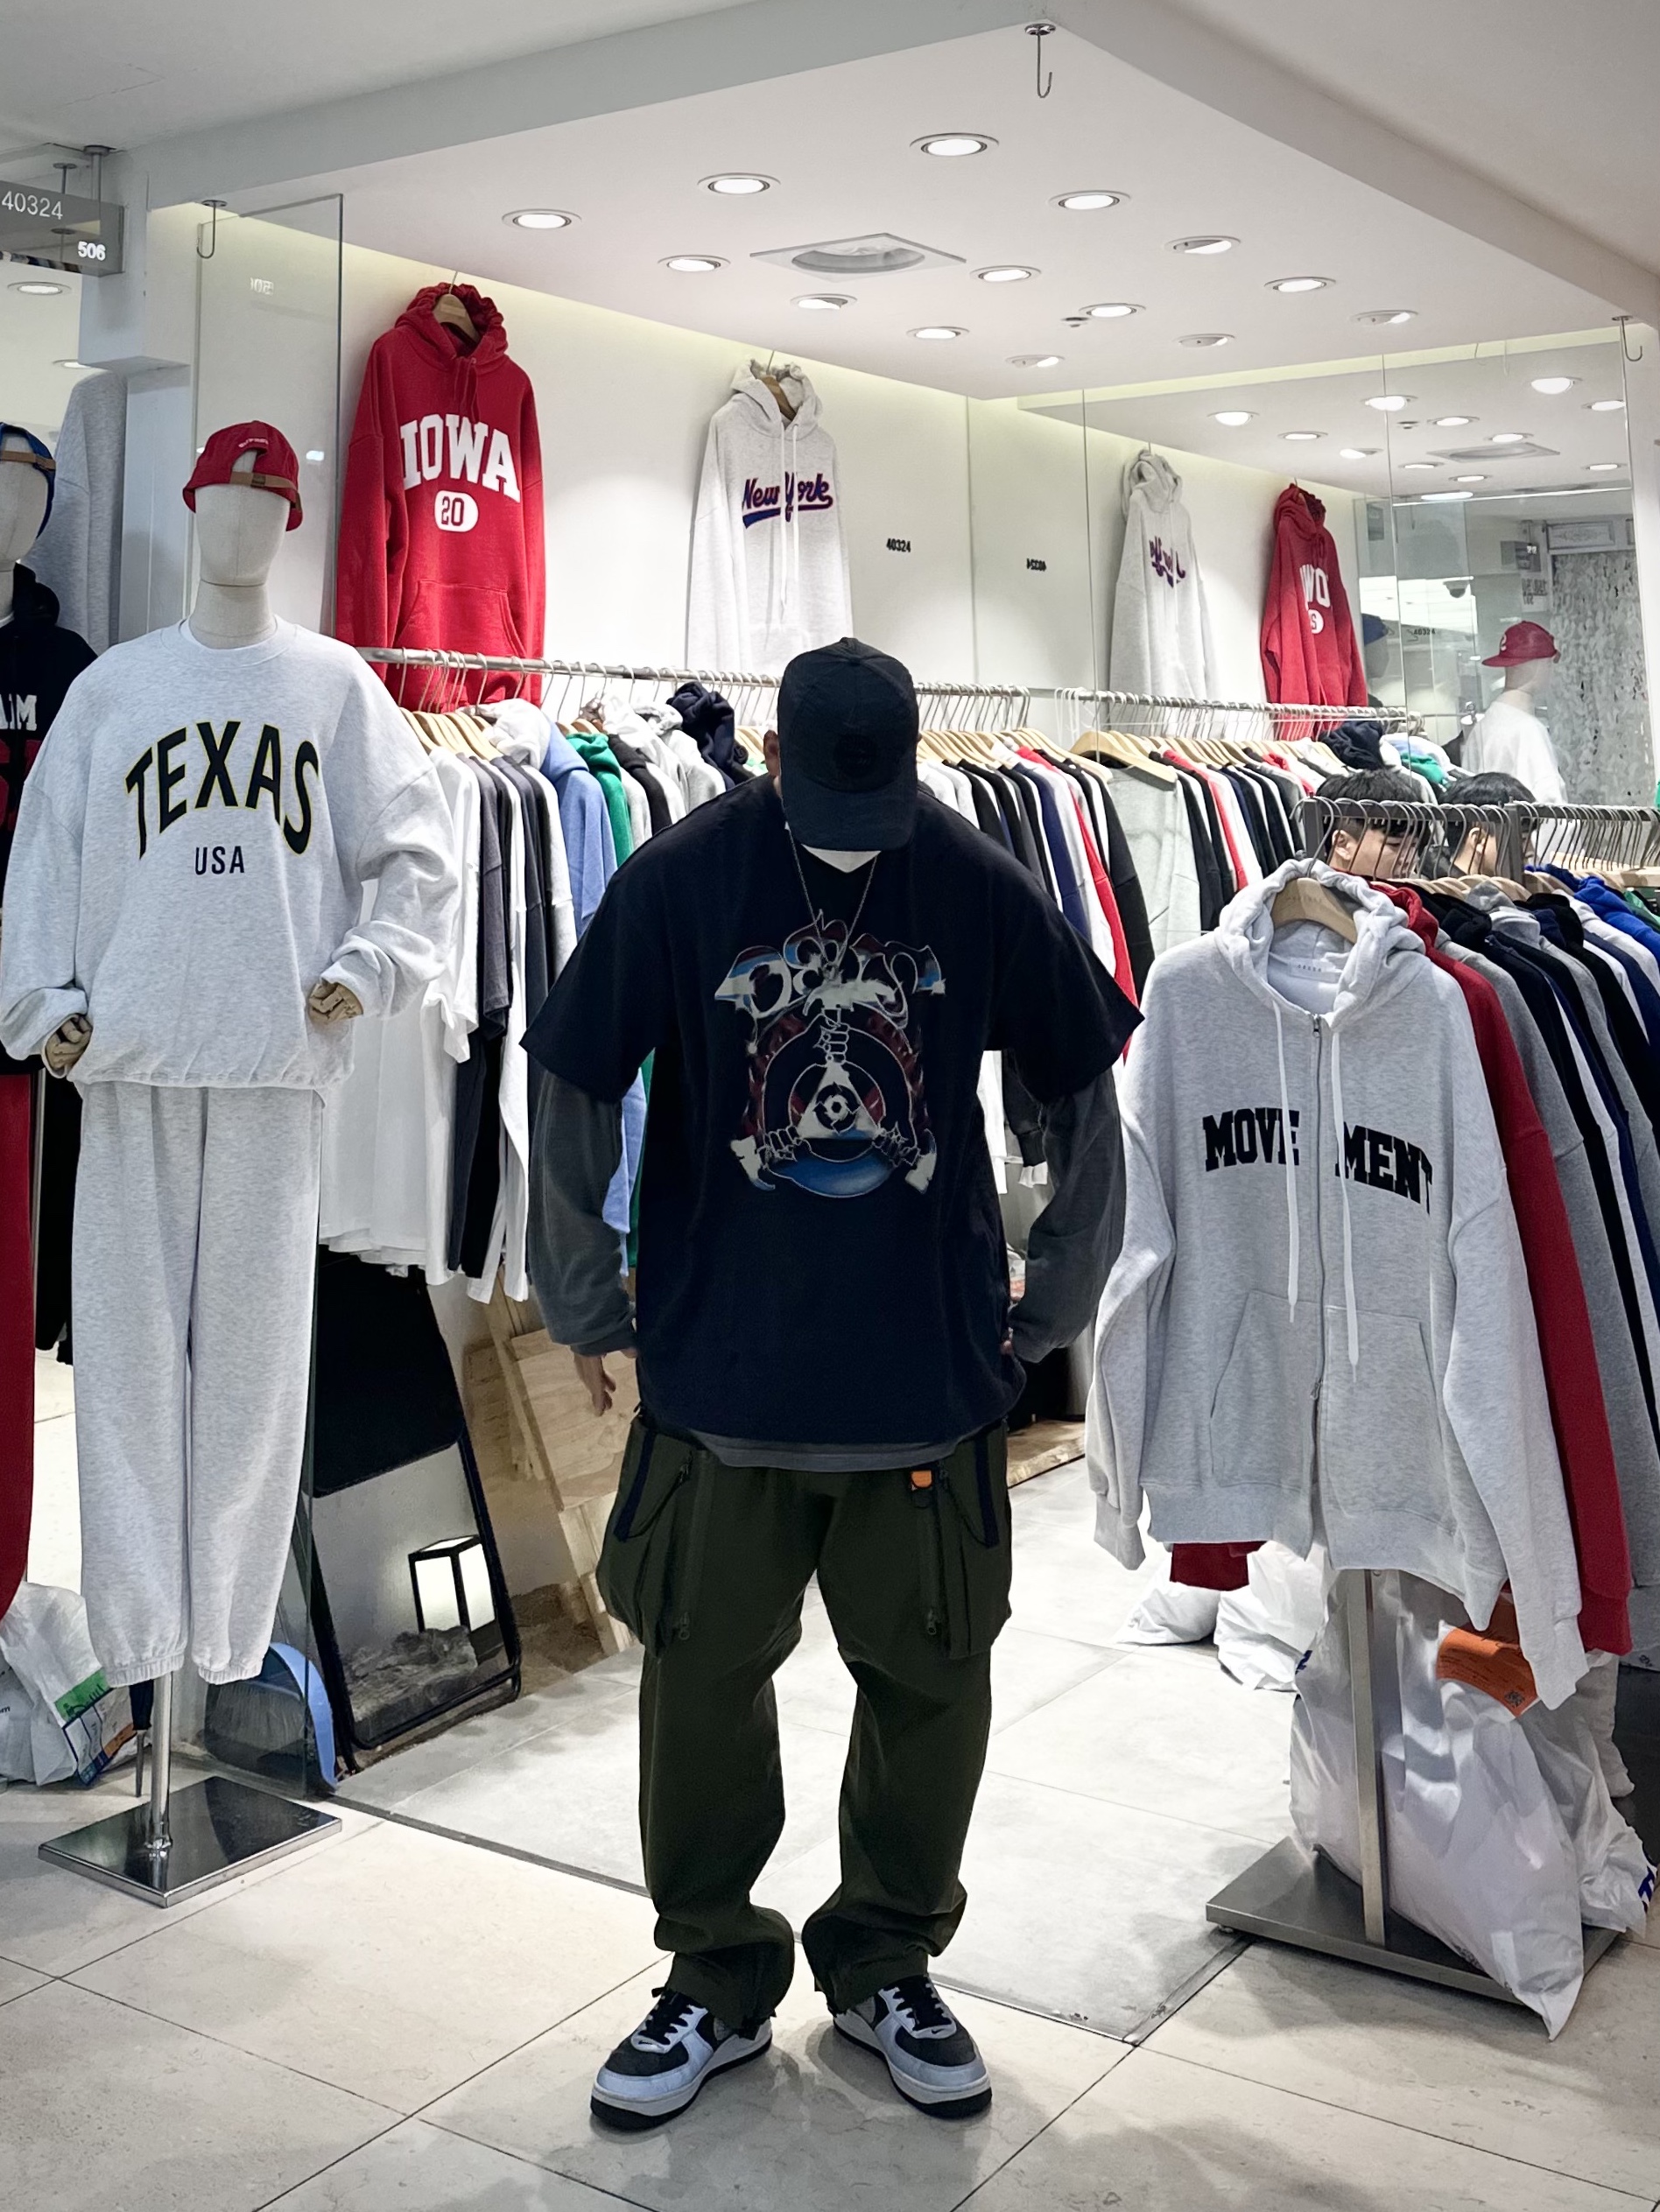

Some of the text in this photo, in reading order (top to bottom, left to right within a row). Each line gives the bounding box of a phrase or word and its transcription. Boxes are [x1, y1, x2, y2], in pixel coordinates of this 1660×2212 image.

[2, 191, 63, 220] 40324
[78, 241, 106, 261] 506
[400, 413, 521, 503] IOWA
[441, 495, 465, 526] 20
[742, 472, 829, 523] New York
[886, 538, 911, 552] 40324
[125, 720, 320, 860] TEXAS
[195, 846, 245, 875] USA
[1203, 1107, 1299, 1172] MOVE
